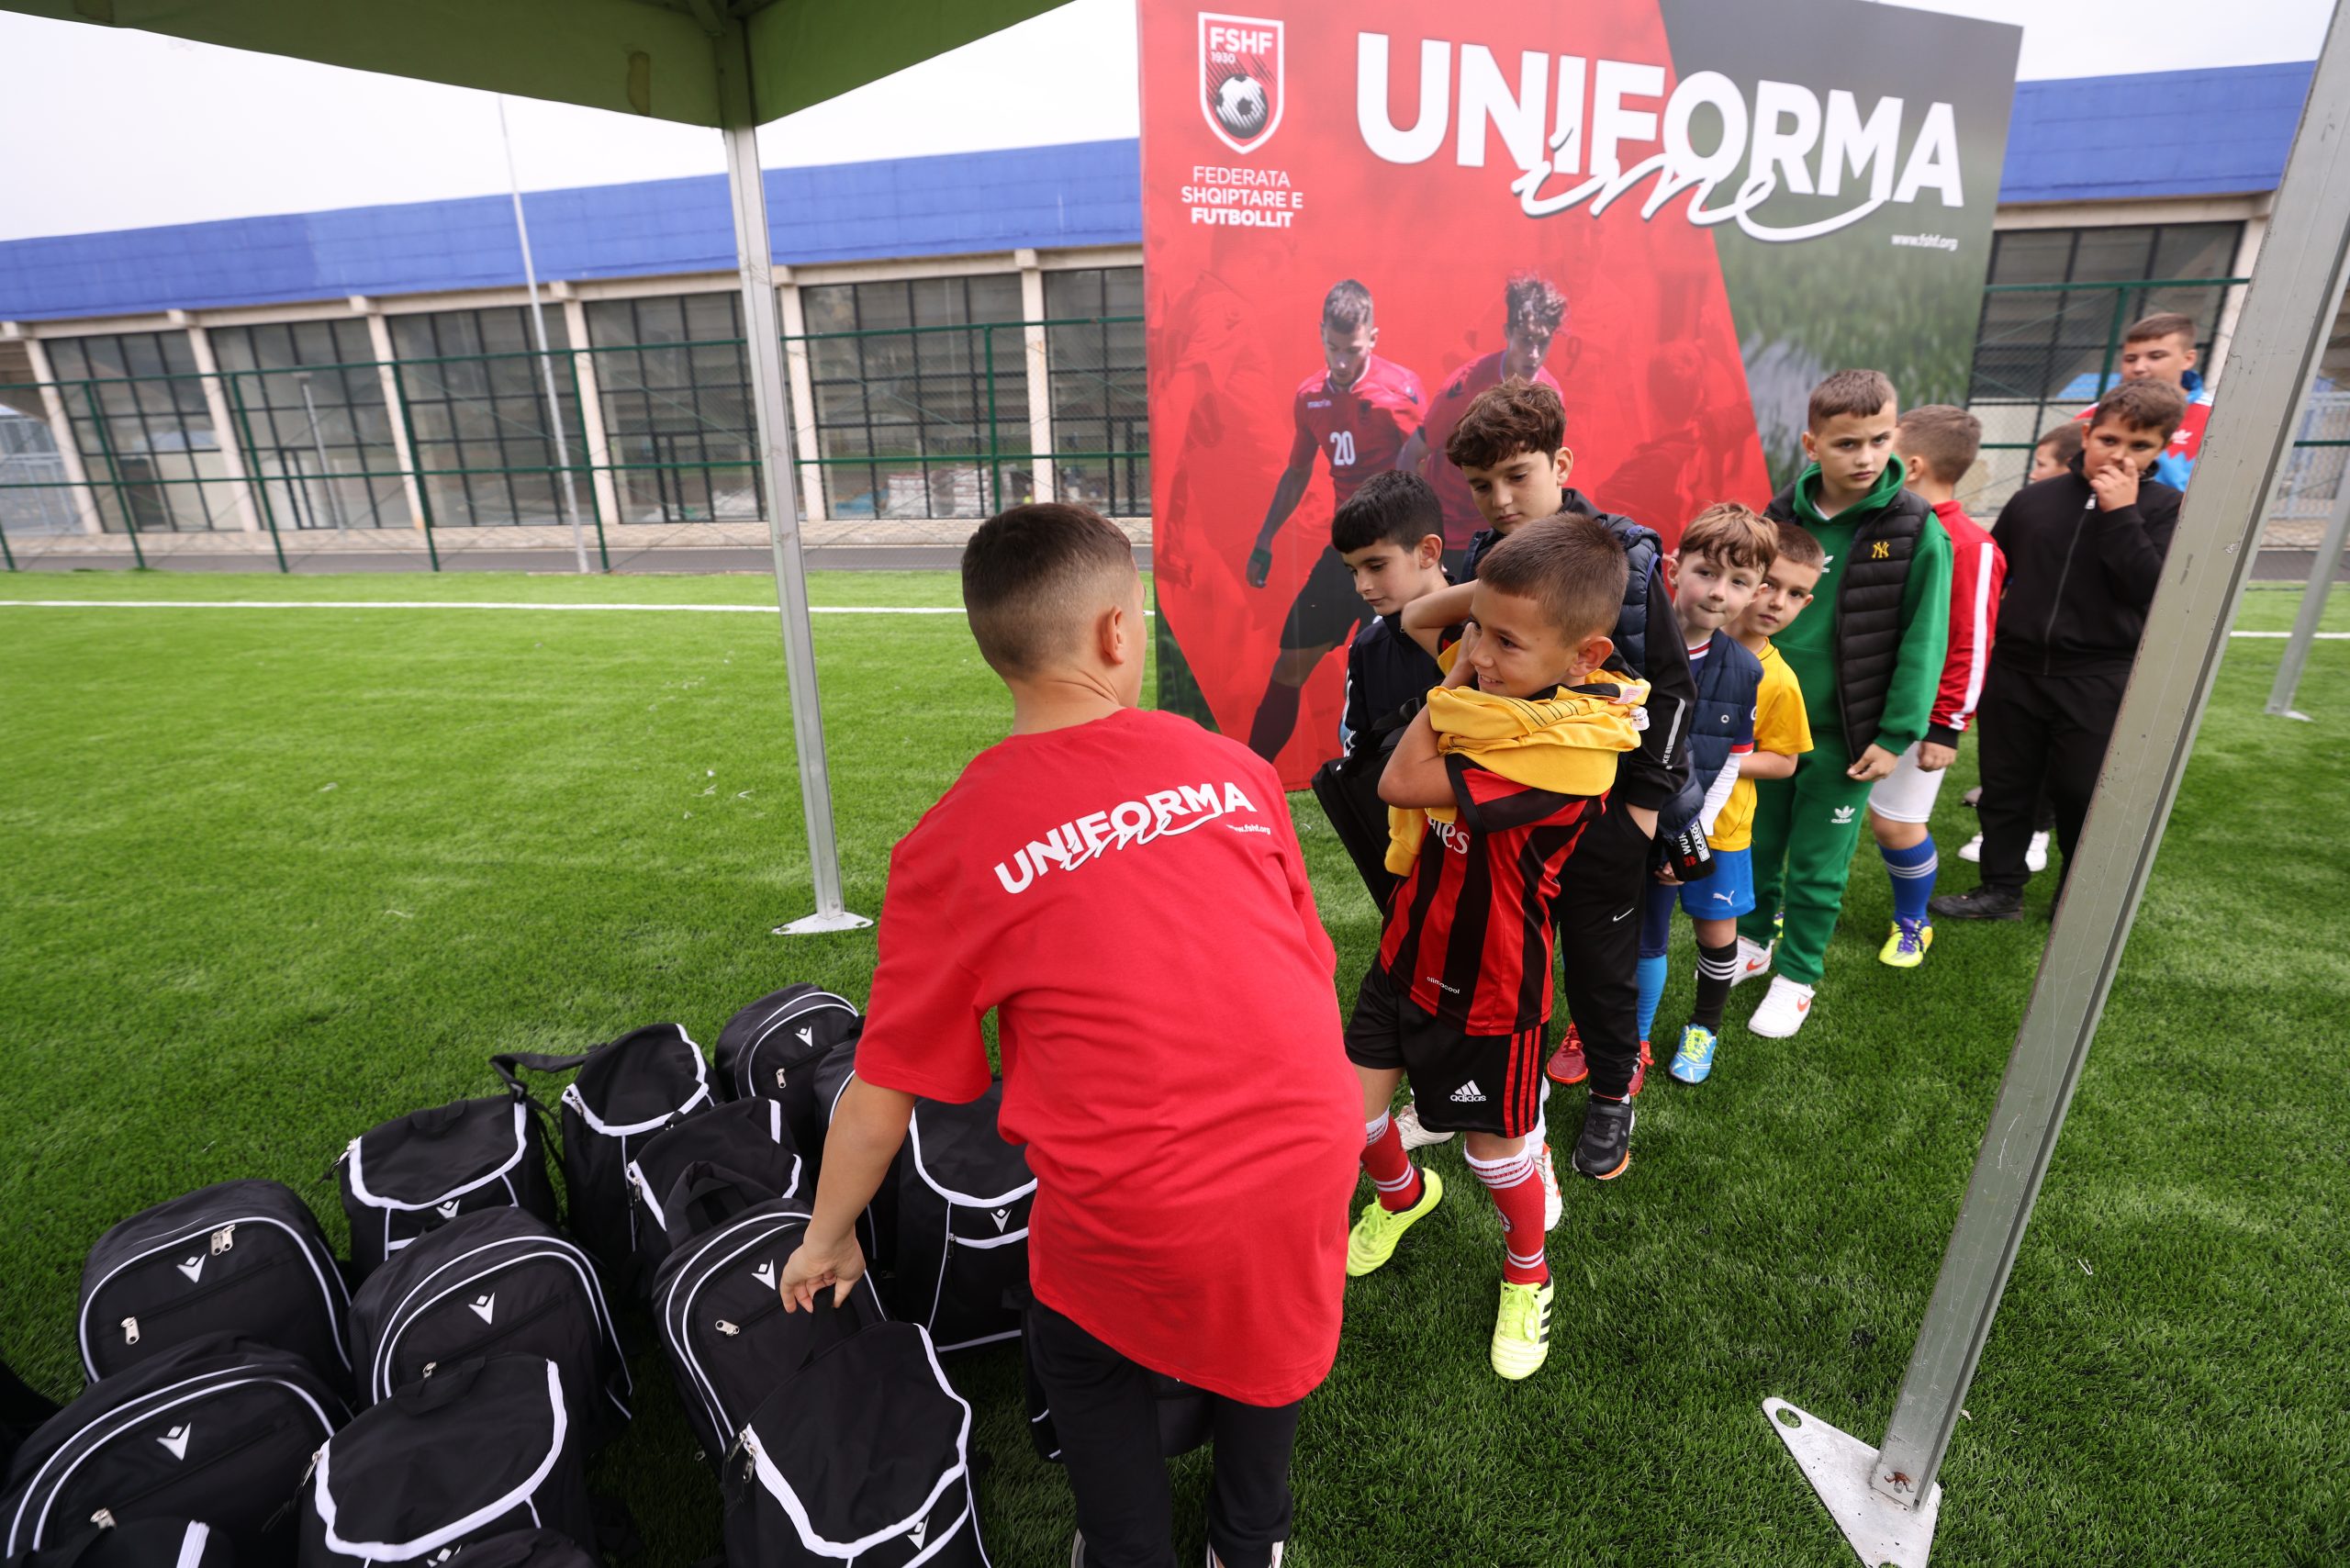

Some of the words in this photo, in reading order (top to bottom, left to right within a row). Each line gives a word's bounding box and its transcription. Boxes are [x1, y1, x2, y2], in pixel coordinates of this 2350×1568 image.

[1210, 26, 1274, 55] FSHF
[1211, 50, 1237, 65] 1930
[1356, 31, 1964, 207] UNIFORMA
[1192, 165, 1292, 188] FEDERATA
[1181, 185, 1287, 207] SHQIPTARE
[1292, 191, 1304, 208] E
[1191, 207, 1294, 229] FUTBOLLIT
[1329, 431, 1357, 465] 20
[993, 781, 1258, 894] UNIFORMA
[1449, 1093, 1487, 1103] adidas
